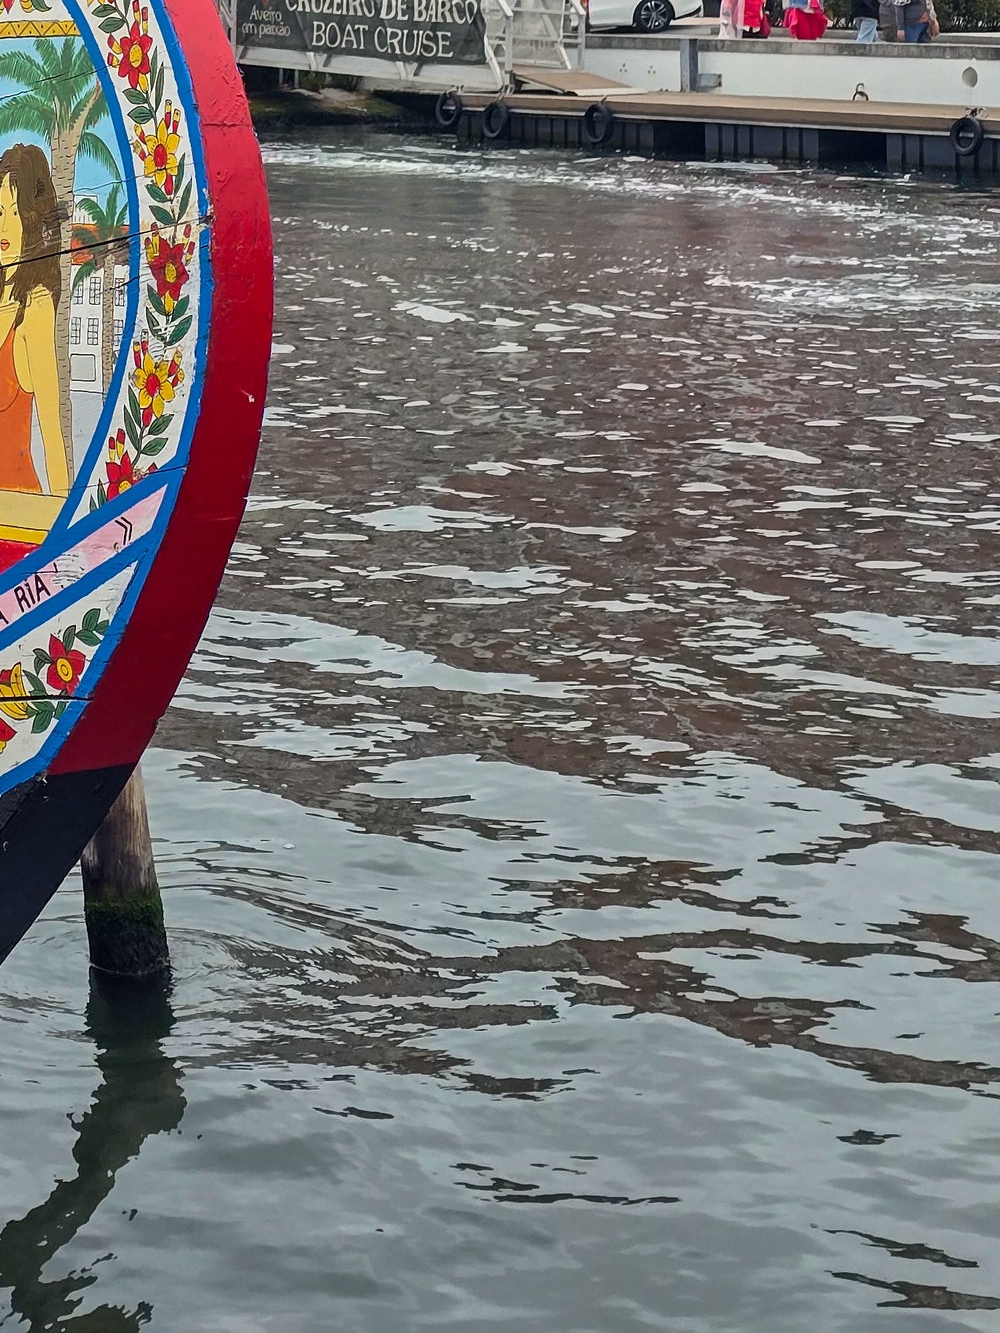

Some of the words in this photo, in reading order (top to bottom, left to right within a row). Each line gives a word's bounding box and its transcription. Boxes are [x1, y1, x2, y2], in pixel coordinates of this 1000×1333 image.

[250, 5, 282, 22] Aveiro
[312, 21, 368, 50] BOAT
[374, 26, 453, 58] CRUISE
